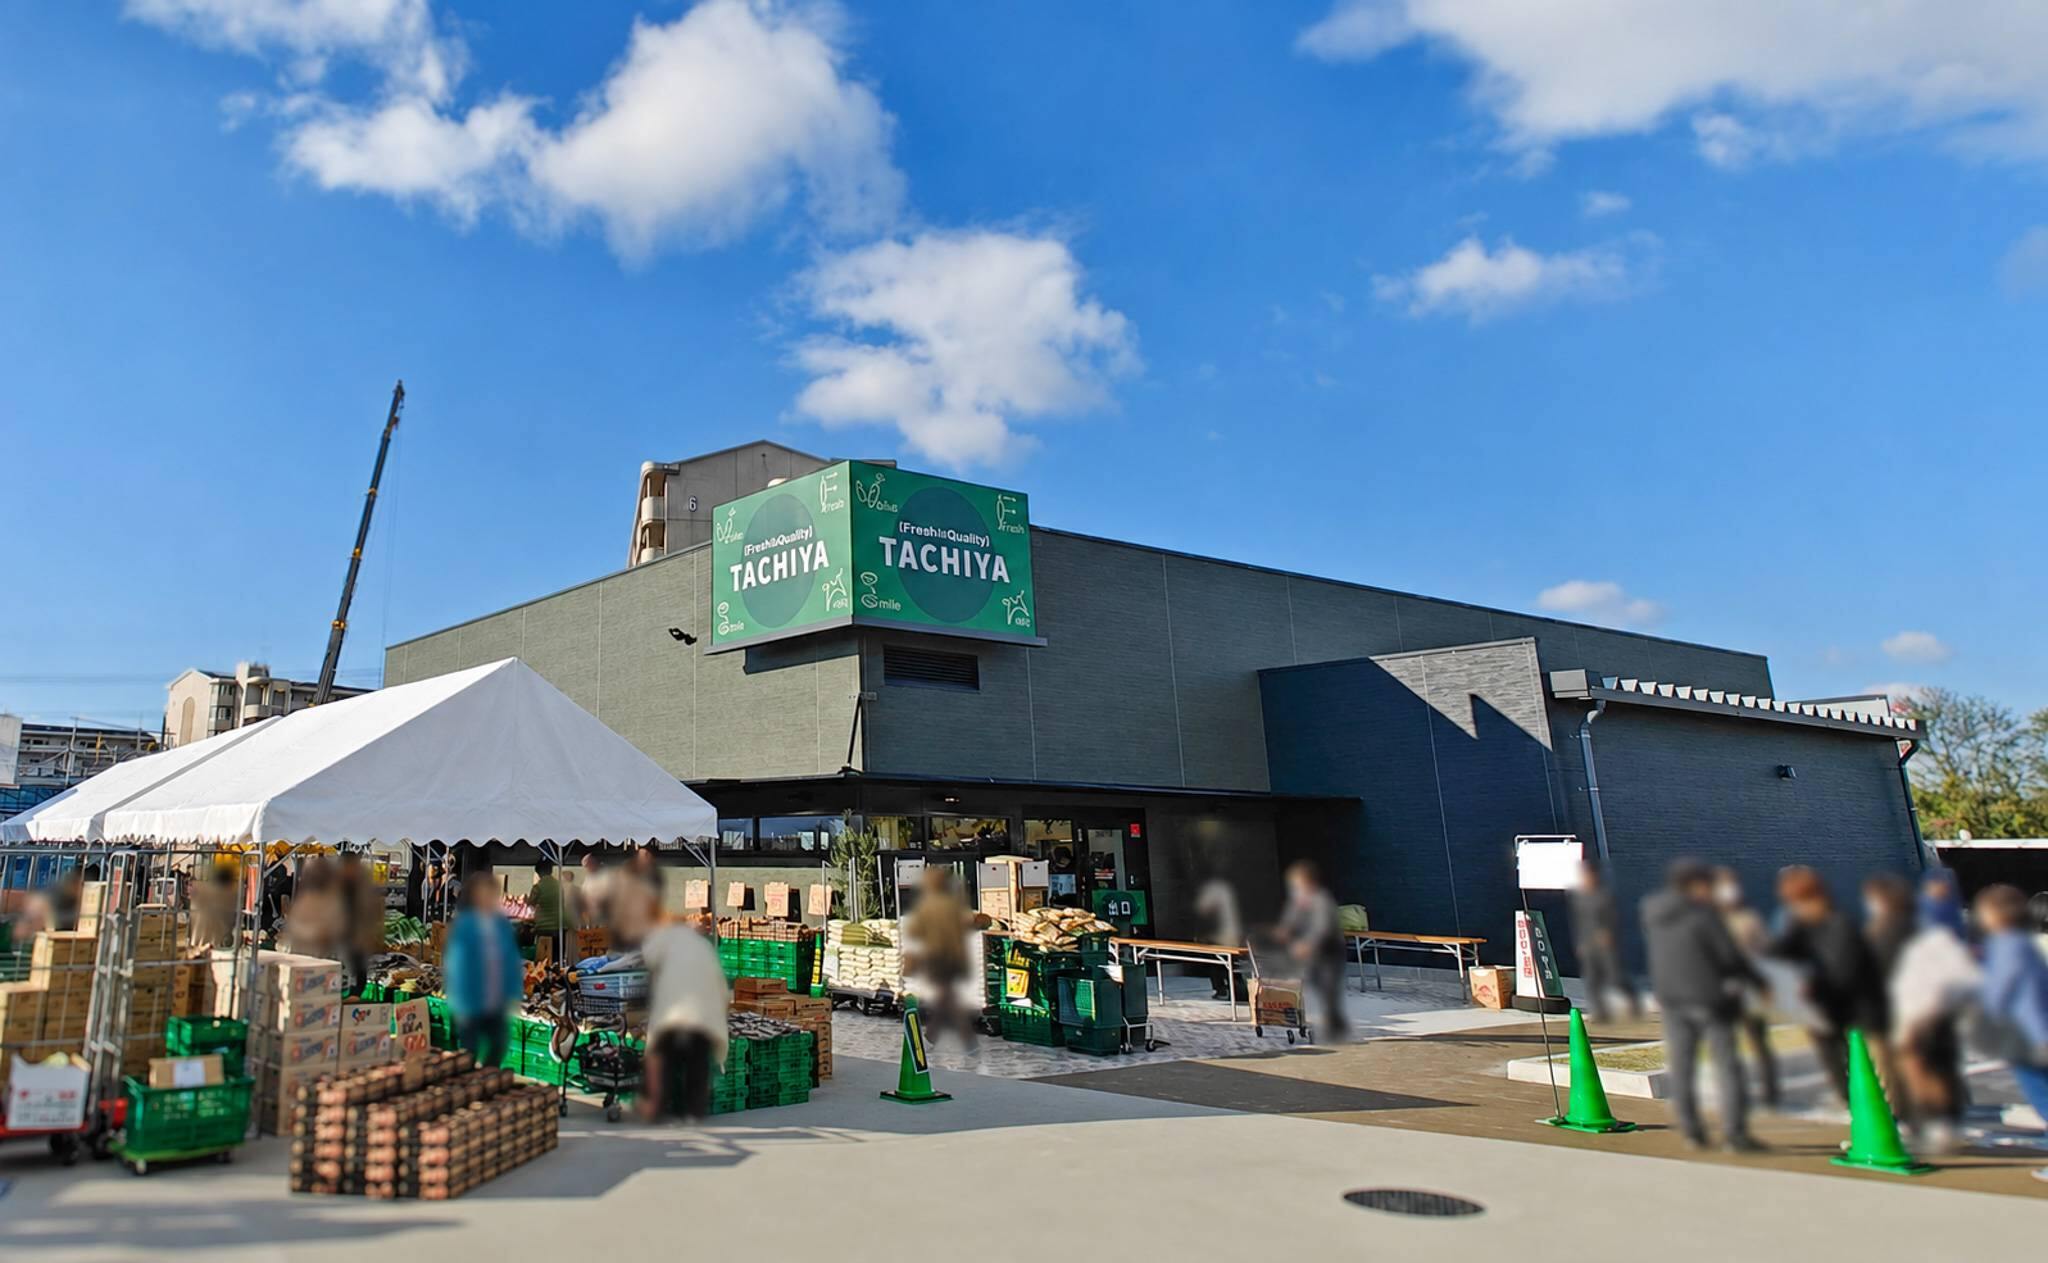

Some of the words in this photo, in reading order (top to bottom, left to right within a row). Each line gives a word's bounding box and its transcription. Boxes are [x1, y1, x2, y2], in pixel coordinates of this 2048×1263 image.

[688, 496, 697, 512] 6
[730, 540, 830, 592] TACHIYA
[878, 536, 1011, 584] TACHIYA
